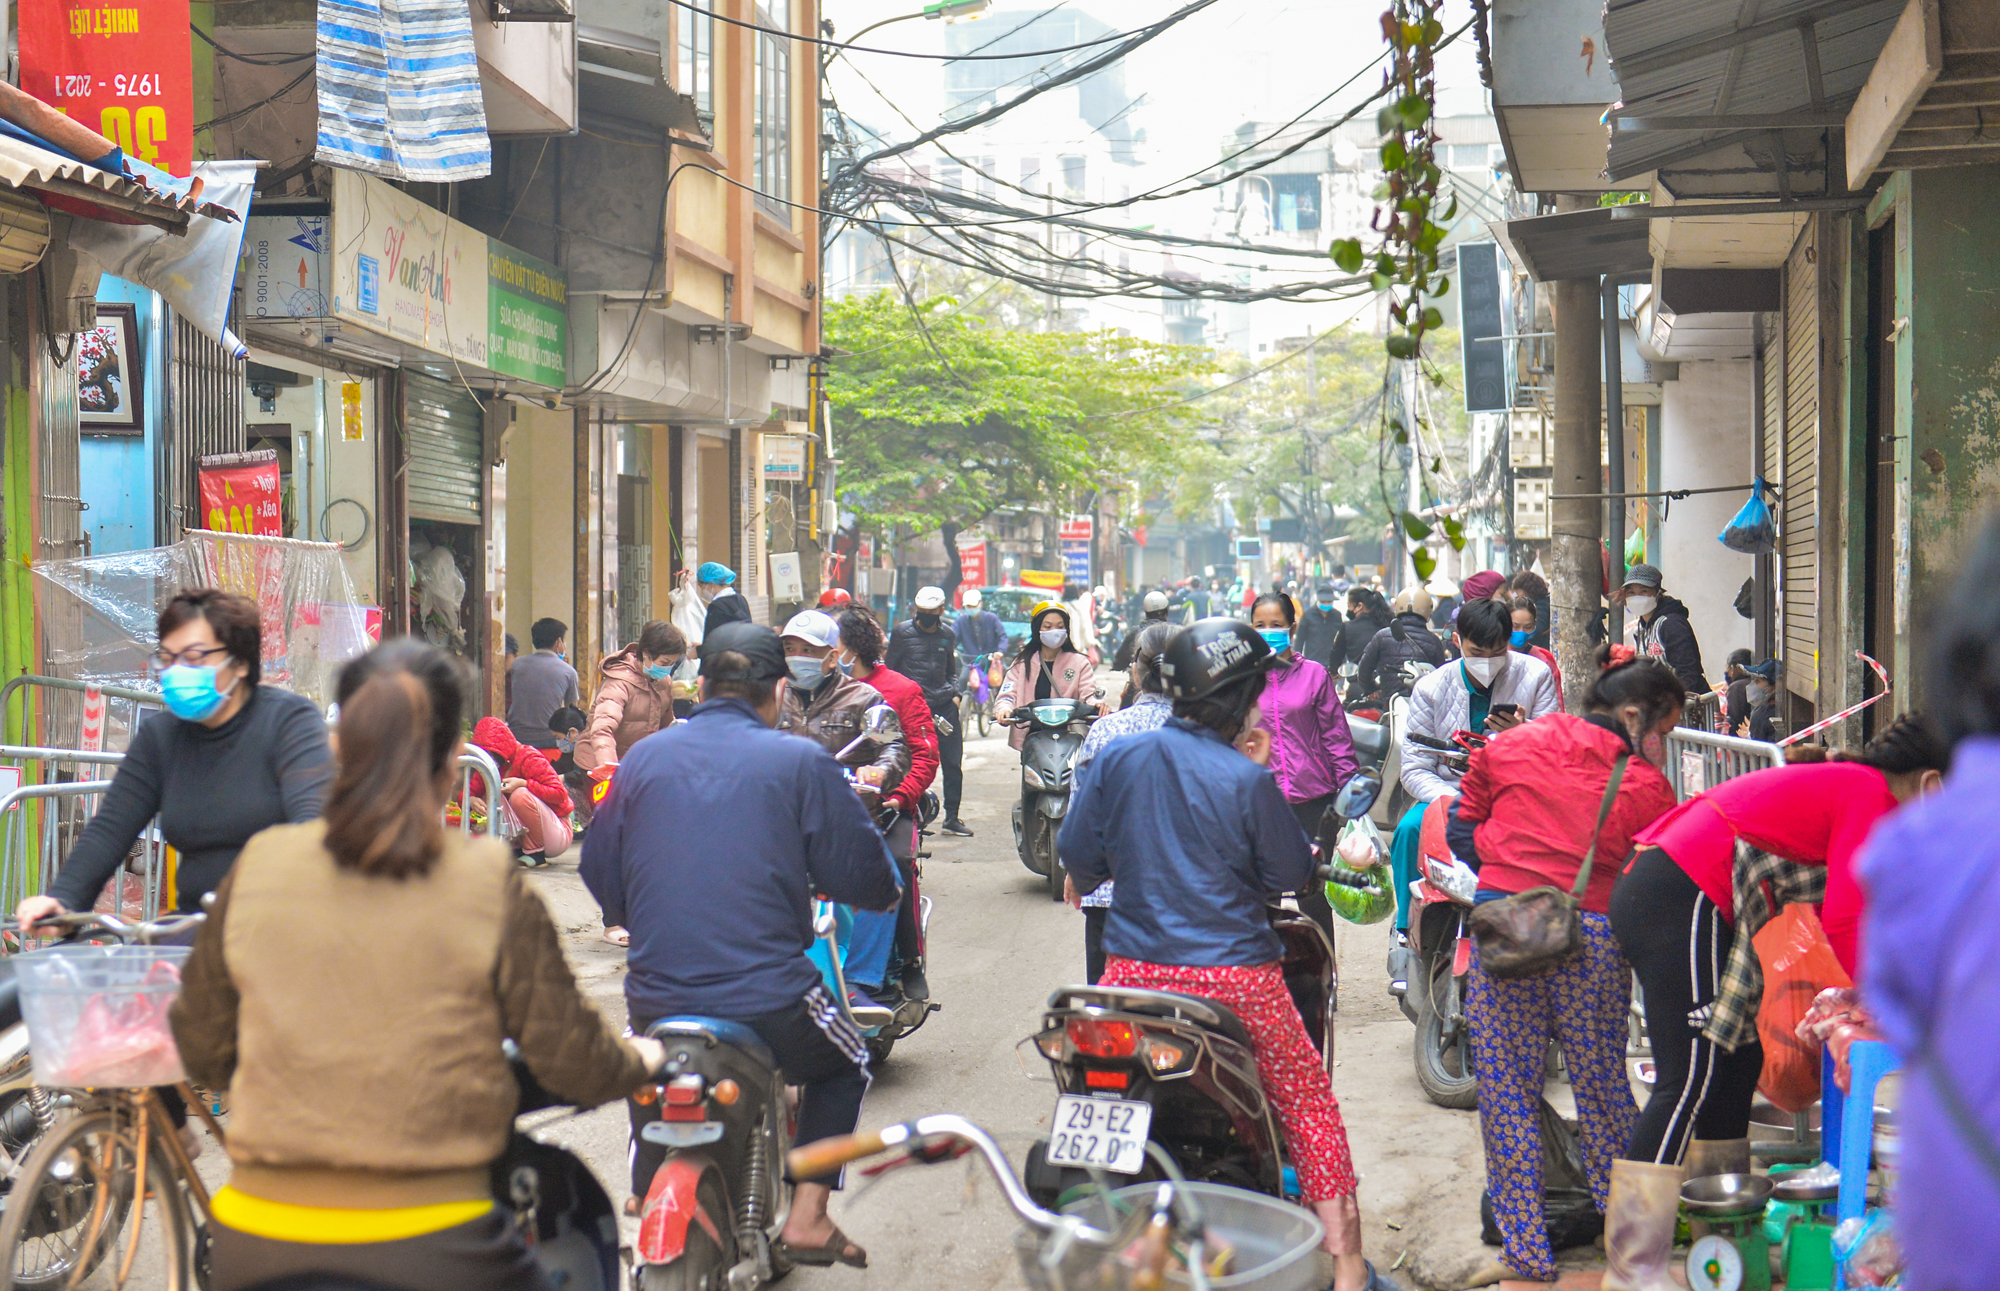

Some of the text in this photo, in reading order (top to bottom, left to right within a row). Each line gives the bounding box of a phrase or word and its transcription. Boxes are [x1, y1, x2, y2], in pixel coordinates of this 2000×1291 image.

[69, 4, 138, 38] NHIỆT LIỆT
[55, 75, 91, 97] 2021
[114, 73, 161, 97] 1975
[256, 240, 268, 303] 9001:2008
[395, 298, 428, 323] HANDMAD
[1068, 1103, 1134, 1134] 29-E2
